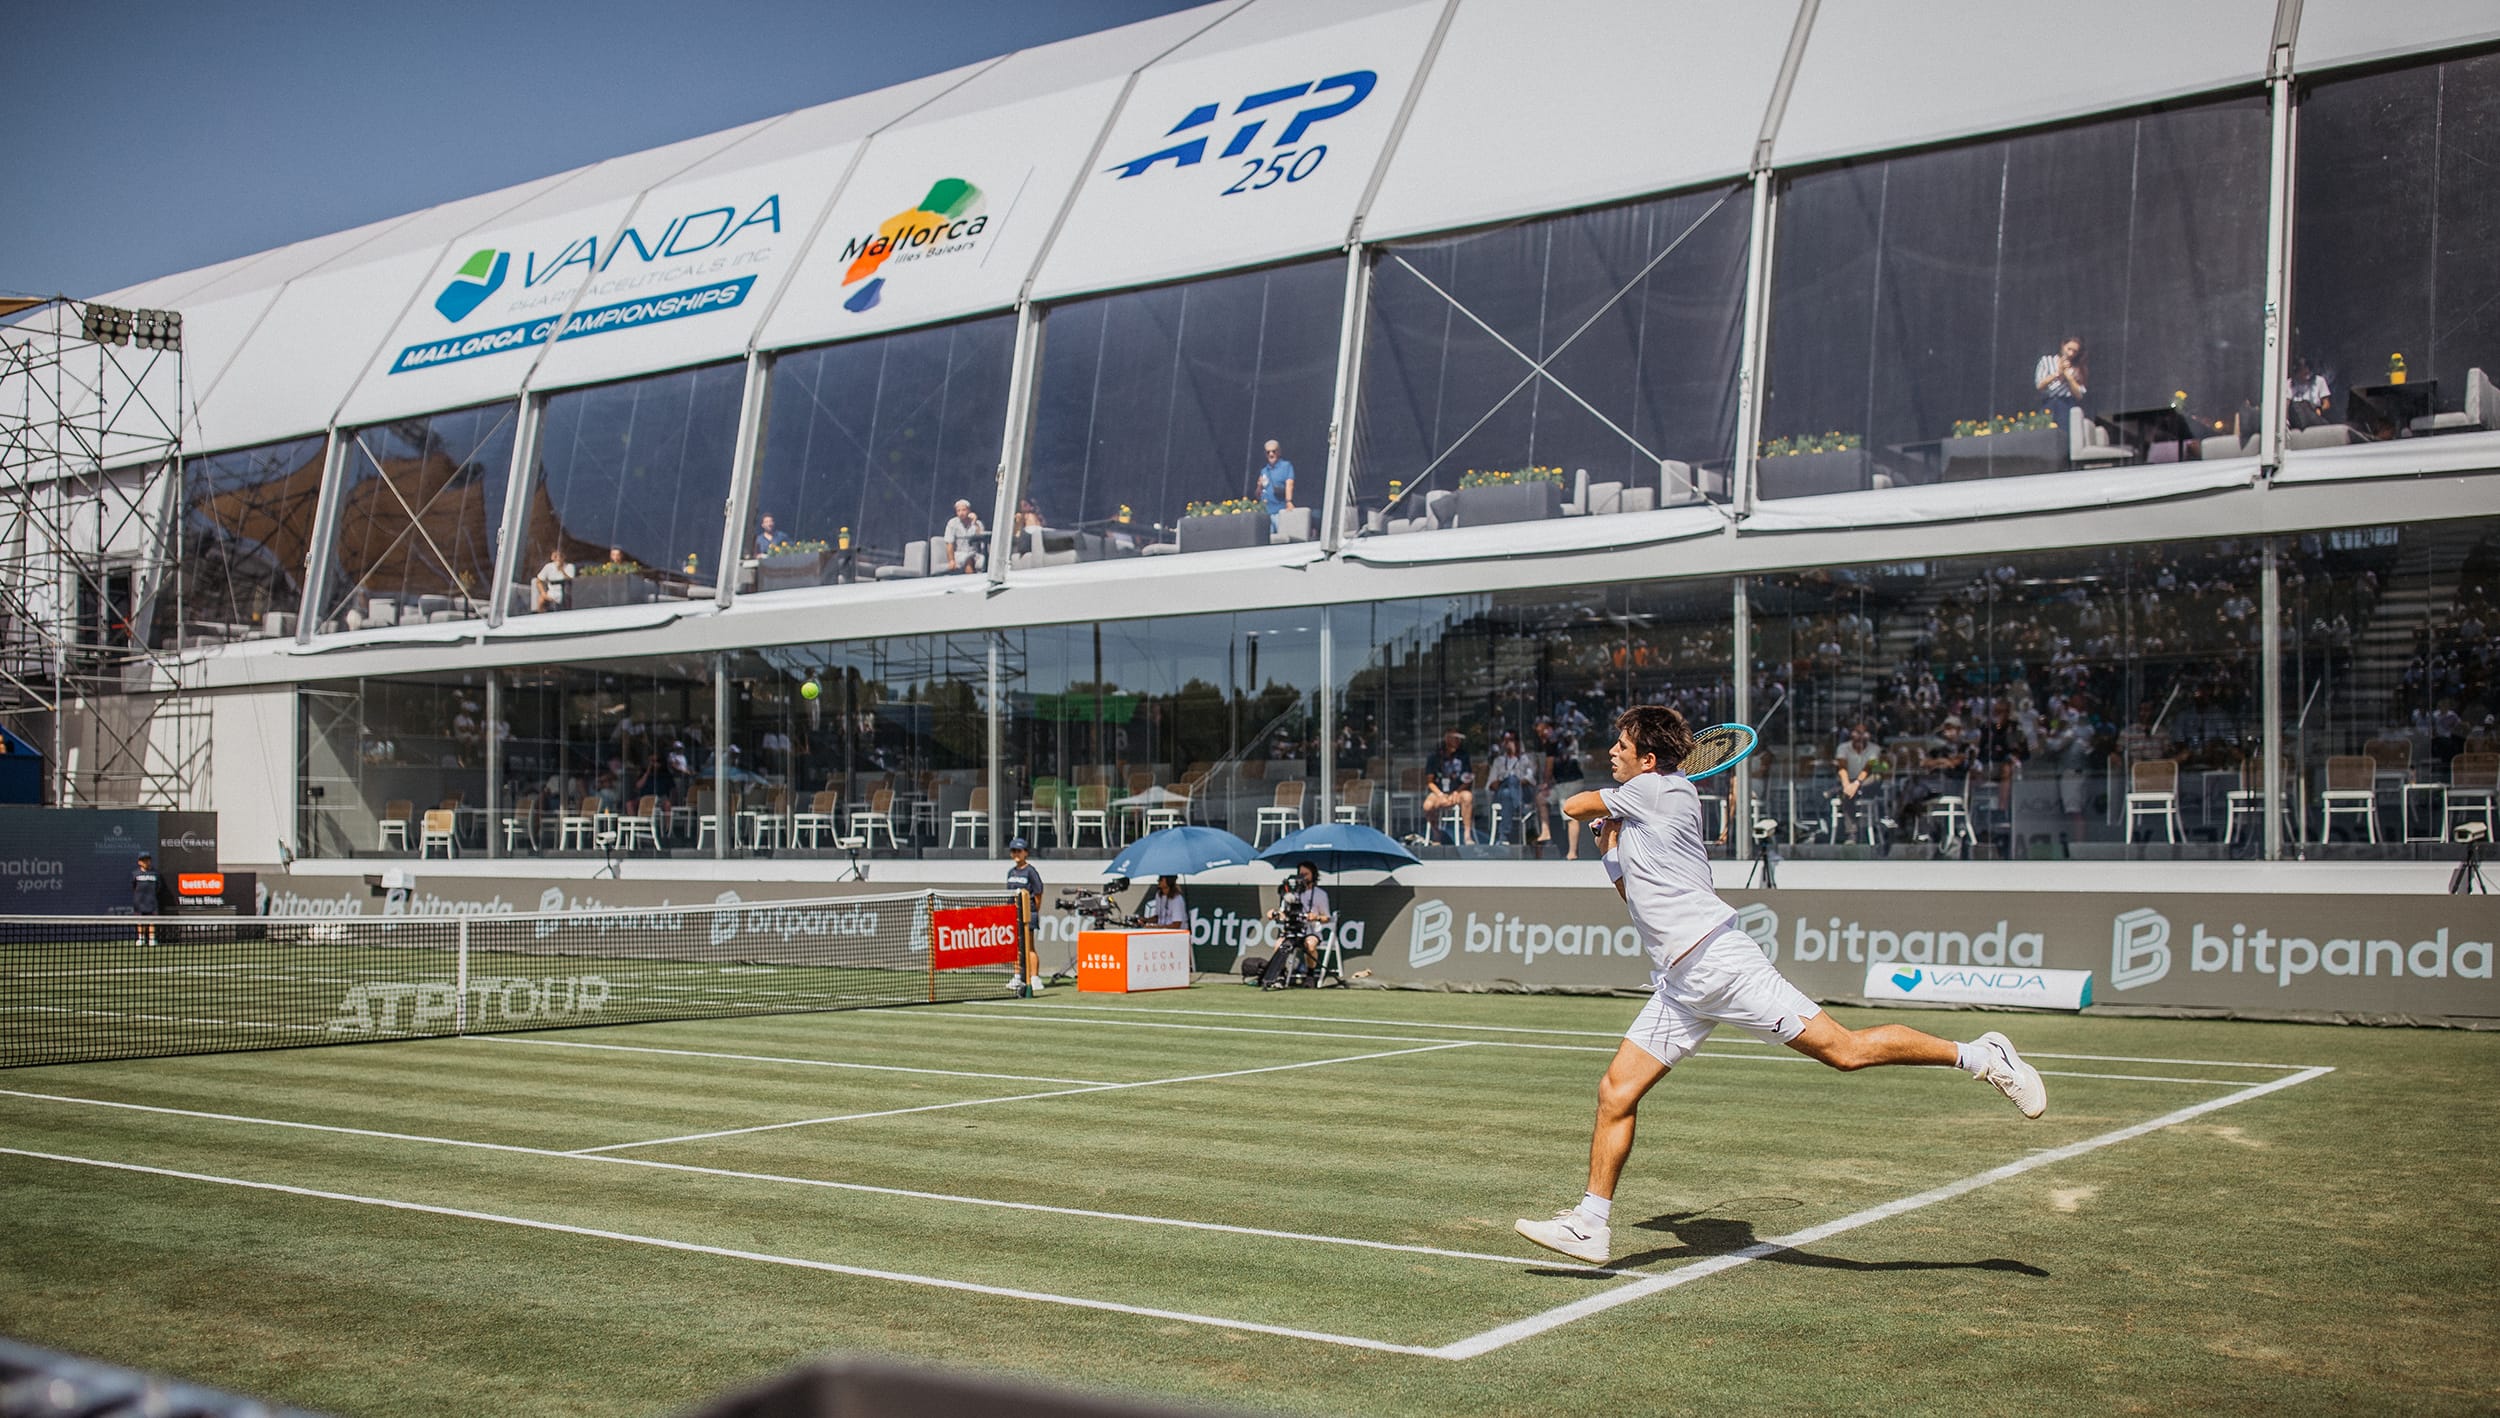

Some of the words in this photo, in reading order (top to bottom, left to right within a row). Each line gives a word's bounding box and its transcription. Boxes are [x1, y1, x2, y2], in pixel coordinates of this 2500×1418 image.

[1101, 70, 1377, 180] ATP
[1219, 145, 1328, 196] 250
[525, 193, 780, 288] VANDA
[838, 215, 988, 263] Mallorca
[926, 241, 976, 258] Balears
[401, 327, 527, 368] MALLORCA
[531, 285, 740, 340] CHAMPIONSHIPS
[17, 878, 62, 893] sports
[938, 923, 1015, 951] Emirates
[1087, 953, 1115, 961] LUCA
[1143, 951, 1175, 960] LUCA
[1465, 912, 1642, 965] bitpand
[1794, 917, 2044, 974] bitpanda
[2190, 923, 2494, 988] bitpanda
[323, 981, 458, 1029] ATP
[469, 976, 610, 1022] TOUR
[1930, 971, 2045, 990] VANDA
